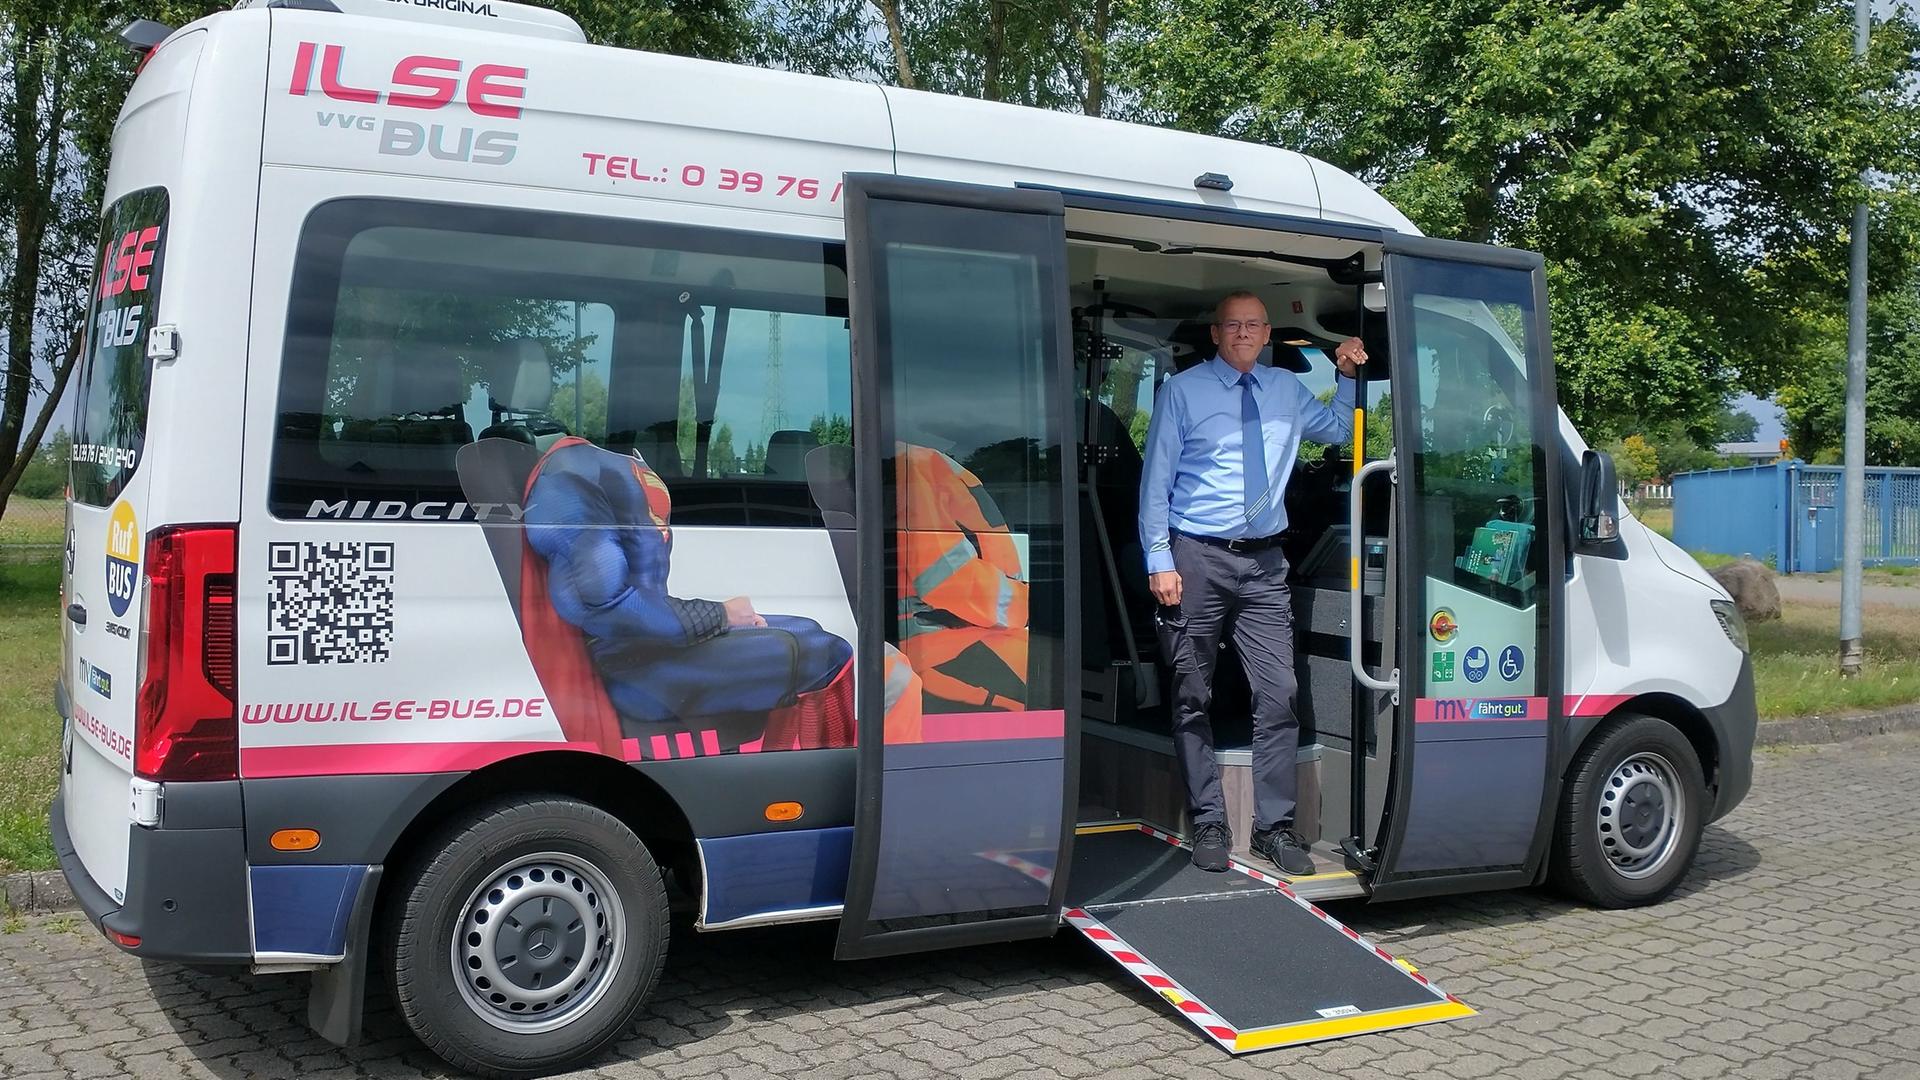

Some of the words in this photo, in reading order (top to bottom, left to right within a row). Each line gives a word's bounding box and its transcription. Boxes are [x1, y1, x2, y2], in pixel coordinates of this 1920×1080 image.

[288, 41, 528, 120] ILSE
[317, 111, 375, 131] VVG
[378, 118, 519, 165] BUS
[582, 152, 668, 183] TEL.:
[681, 165, 706, 187] 0
[718, 168, 763, 193] 39
[776, 175, 819, 200] 76
[98, 226, 160, 301] ILSE
[103, 305, 143, 348] BUS
[115, 447, 136, 469] 240
[305, 499, 538, 521] MIDCITY
[111, 520, 134, 556] Ruf
[109, 561, 132, 600] BUS
[241, 698, 546, 725] WWW.ILSE-BUS.DE
[1478, 702, 1502, 714] fährt
[1504, 703, 1524, 716] gut.
